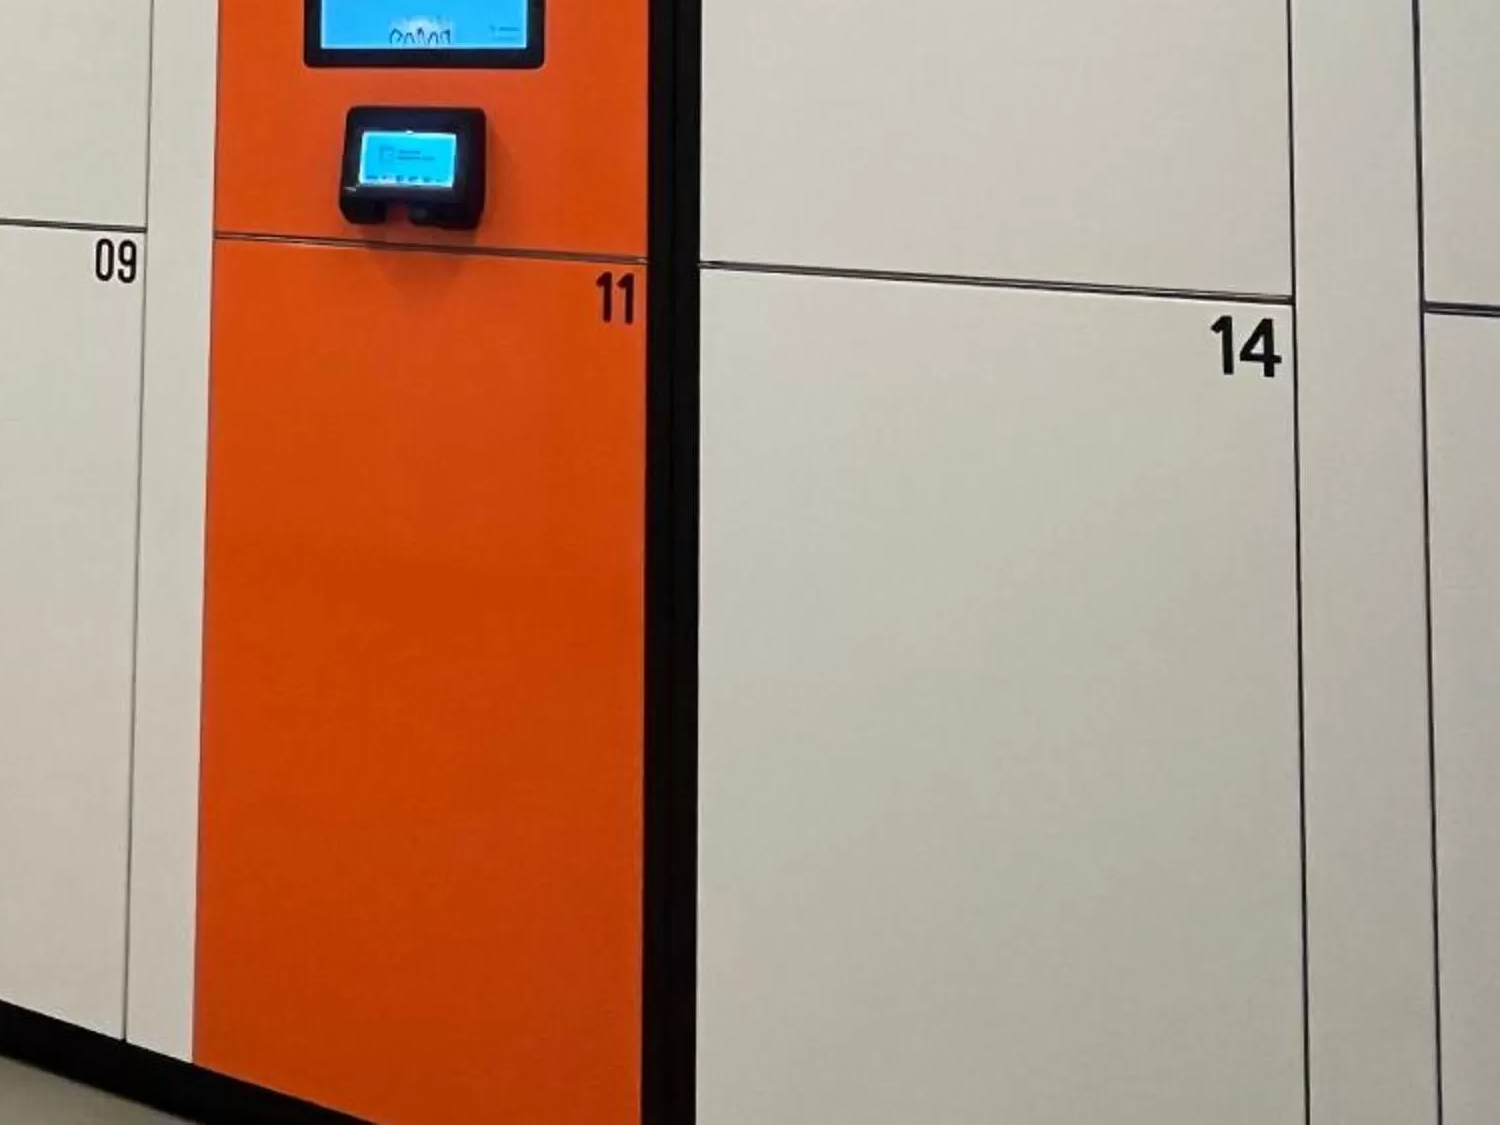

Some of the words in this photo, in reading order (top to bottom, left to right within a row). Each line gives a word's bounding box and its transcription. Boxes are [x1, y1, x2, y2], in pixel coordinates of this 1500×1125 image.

[96, 239, 137, 283] 09
[597, 272, 634, 323] 11
[1211, 316, 1282, 377] 14
